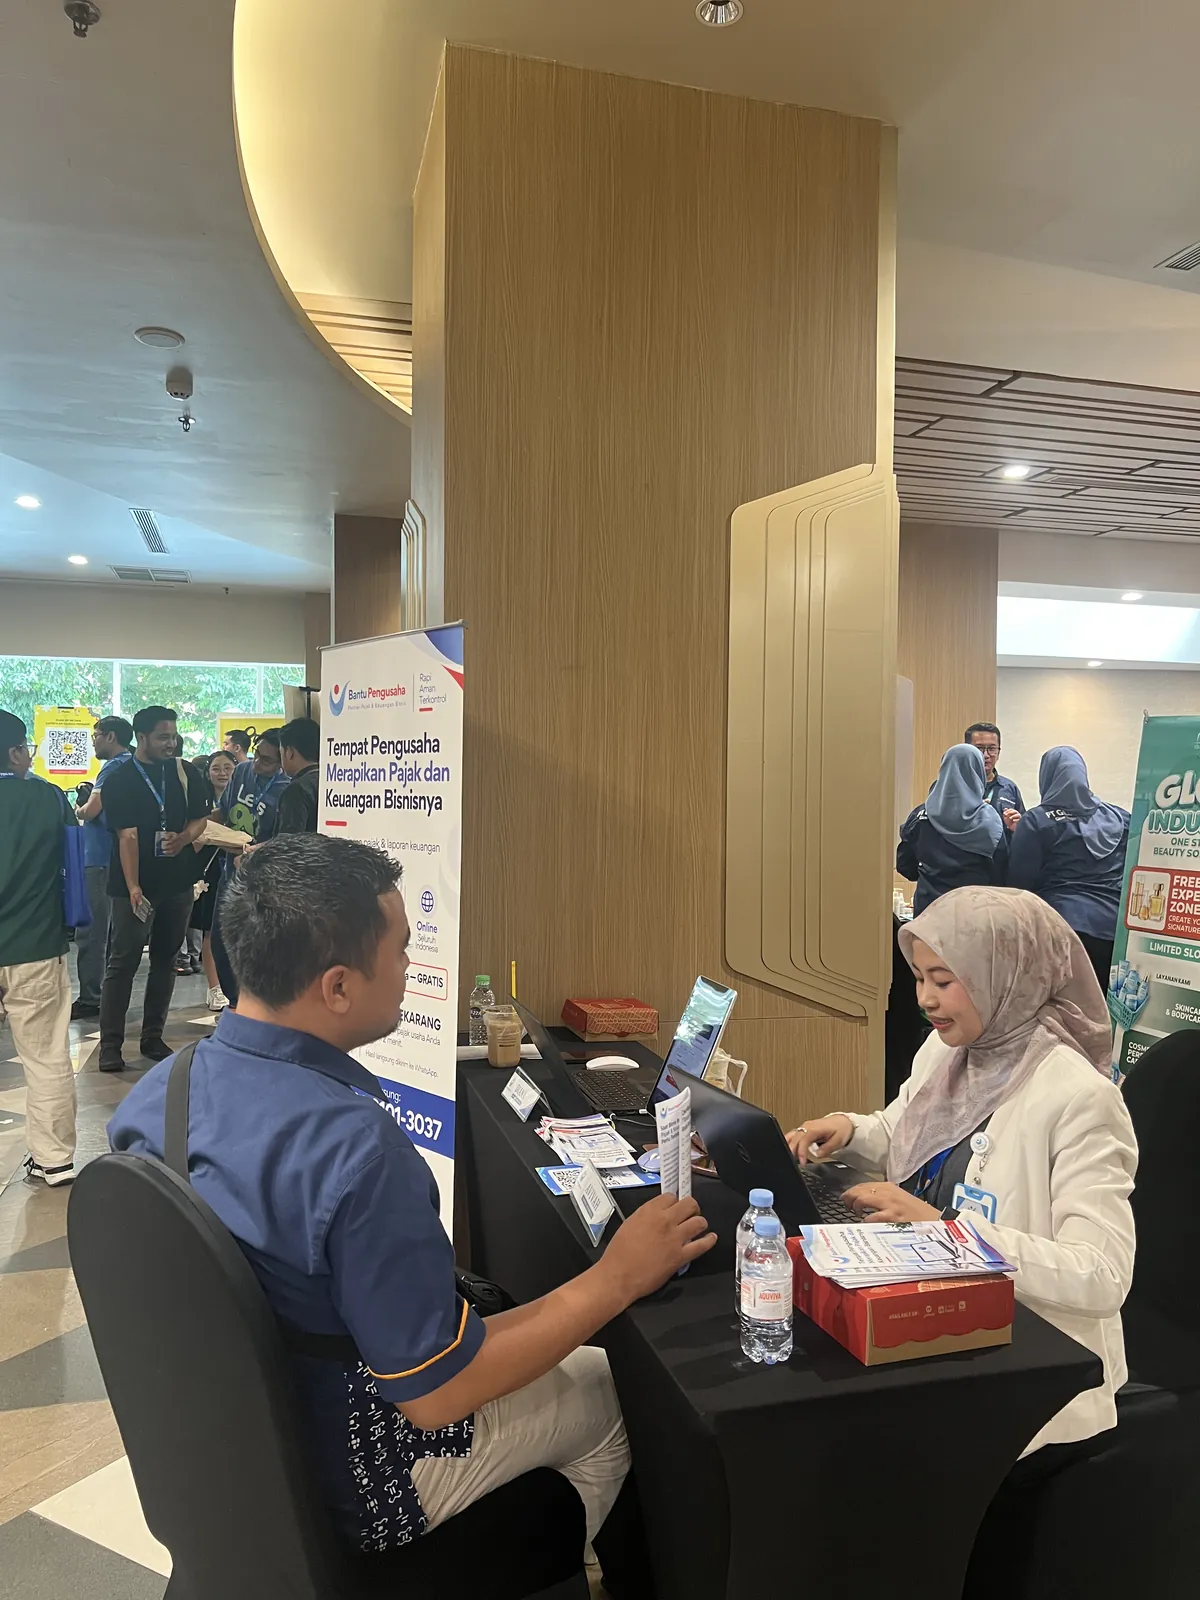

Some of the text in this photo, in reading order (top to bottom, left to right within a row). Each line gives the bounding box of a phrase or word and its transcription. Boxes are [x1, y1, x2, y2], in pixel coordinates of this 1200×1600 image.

[420, 673, 432, 684] Rapi
[348, 684, 406, 700] Bantu Pengusaha
[419, 685, 436, 693] Aman
[419, 694, 447, 705] Terkontrol
[327, 731, 440, 762] Tempat Pengusaha
[326, 760, 450, 788] Merapikan Pajak dan
[325, 788, 443, 817] Keuangan Bisnisnya
[381, 838, 386, 849] &
[386, 839, 409, 852] laporan
[410, 840, 440, 855] keuangan
[1171, 837, 1189, 847] ONE
[1153, 847, 1186, 858] BEAUTY
[1173, 875, 1200, 889] FREE
[1171, 888, 1200, 902] EXPE
[1169, 901, 1200, 915] ZONE
[1168, 915, 1192, 924] CREATE
[416, 921, 438, 934] Online
[1167, 923, 1200, 934] SIGNATURE
[417, 933, 437, 944] Seluruh
[415, 943, 438, 953] Indonesia
[1149, 941, 1182, 955] LIMITED
[417, 973, 444, 988] GRATIS
[1156, 973, 1178, 983] LAYANAN
[400, 1009, 441, 1031] EKARANG
[410, 1031, 425, 1042] usaha
[426, 1034, 441, 1046] Anda
[382, 1089, 401, 1104] sung:
